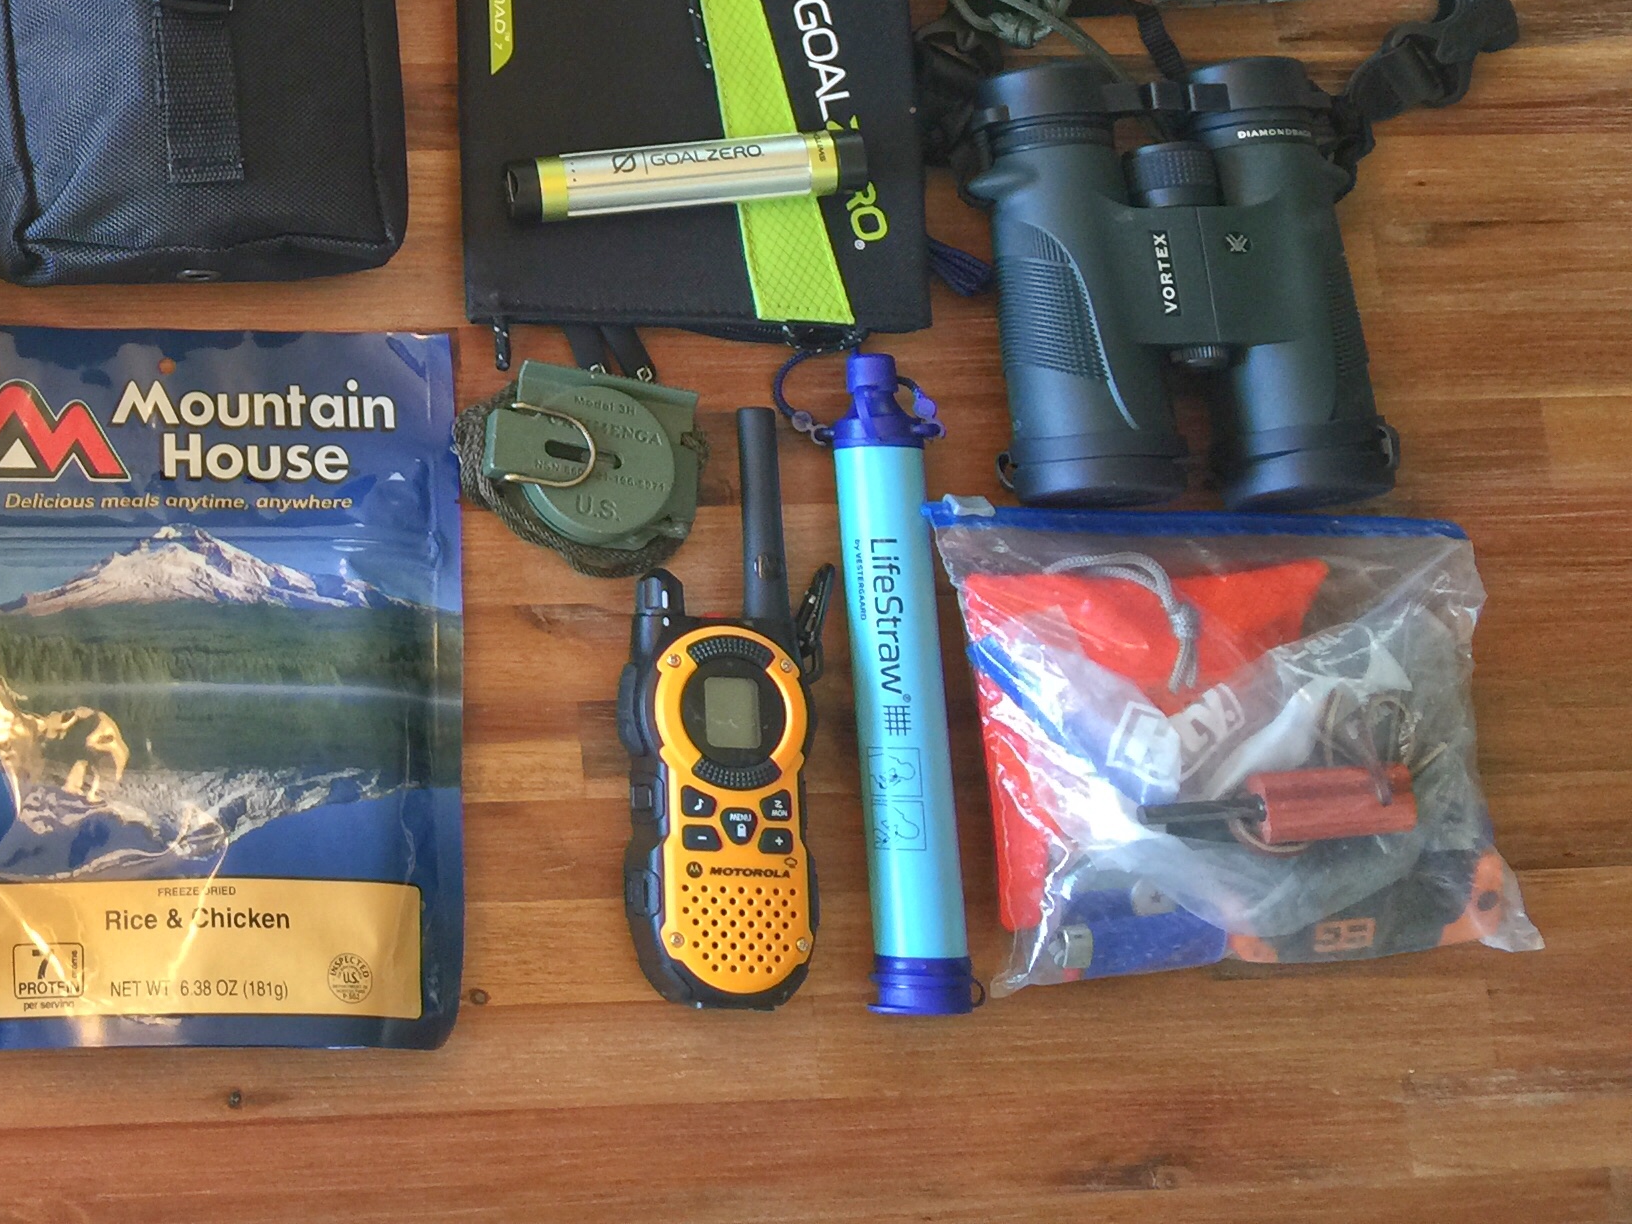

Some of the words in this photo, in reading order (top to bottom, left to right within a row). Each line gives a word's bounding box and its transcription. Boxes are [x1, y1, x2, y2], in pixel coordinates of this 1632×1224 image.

[1152, 233, 1178, 314] VORTEX
[111, 378, 397, 429] Mountain
[574, 395, 615, 412] Model
[618, 404, 638, 416] 3H
[162, 433, 350, 481] House
[4, 492, 95, 509] Delicious
[101, 493, 160, 508] meals
[165, 493, 250, 513] anytime,
[255, 494, 353, 514] anywhere
[575, 494, 623, 522] U.S.
[855, 552, 867, 622] VESTERGAARD
[870, 538, 905, 695] LifeStraw
[729, 813, 753, 822] MENU
[771, 809, 789, 817] MON
[710, 866, 791, 879] MOTOROLA
[157, 886, 200, 897] FREEZE
[105, 909, 158, 930] Rice
[166, 908, 183, 929] &
[192, 907, 291, 929] Chicken
[111, 980, 142, 997] NET
[180, 979, 212, 996] 6.38
[216, 979, 238, 996] OZ
[243, 980, 289, 1001] (181g)
[23, 1002, 38, 1012] per
